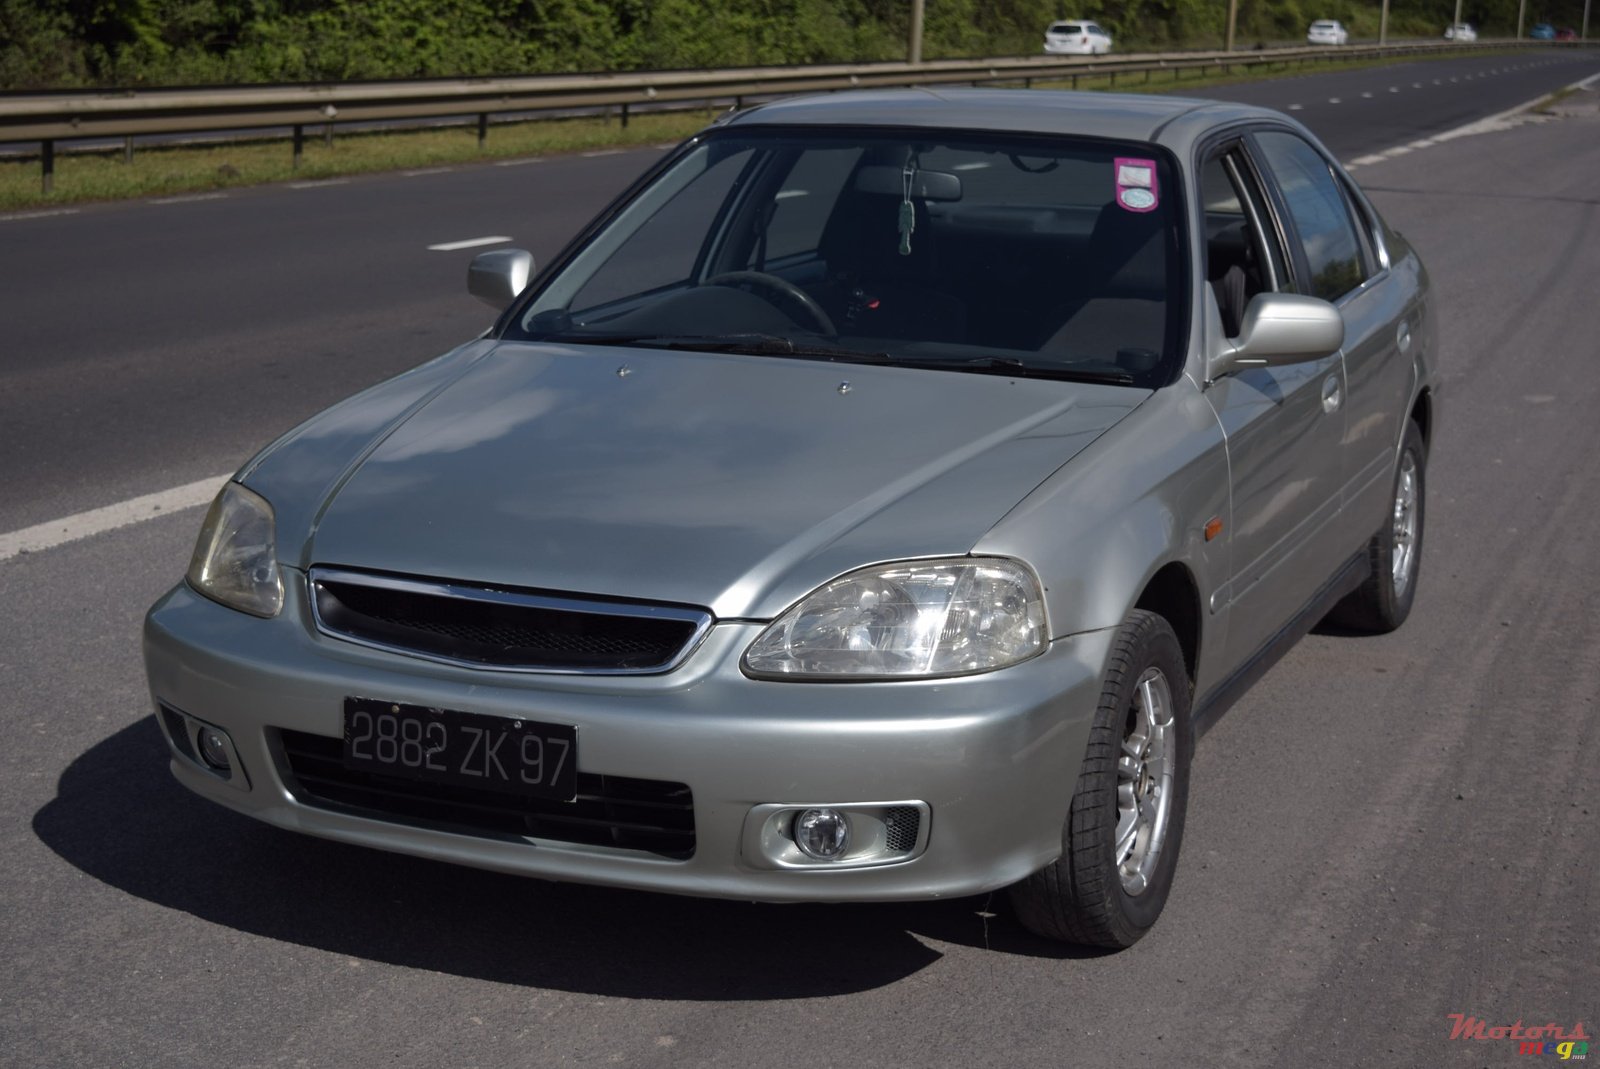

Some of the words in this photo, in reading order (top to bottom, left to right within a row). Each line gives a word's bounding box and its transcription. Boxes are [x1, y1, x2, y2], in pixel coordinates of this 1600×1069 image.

[352, 711, 447, 772] 2882
[459, 726, 510, 781] ZK
[520, 734, 570, 787] 97
